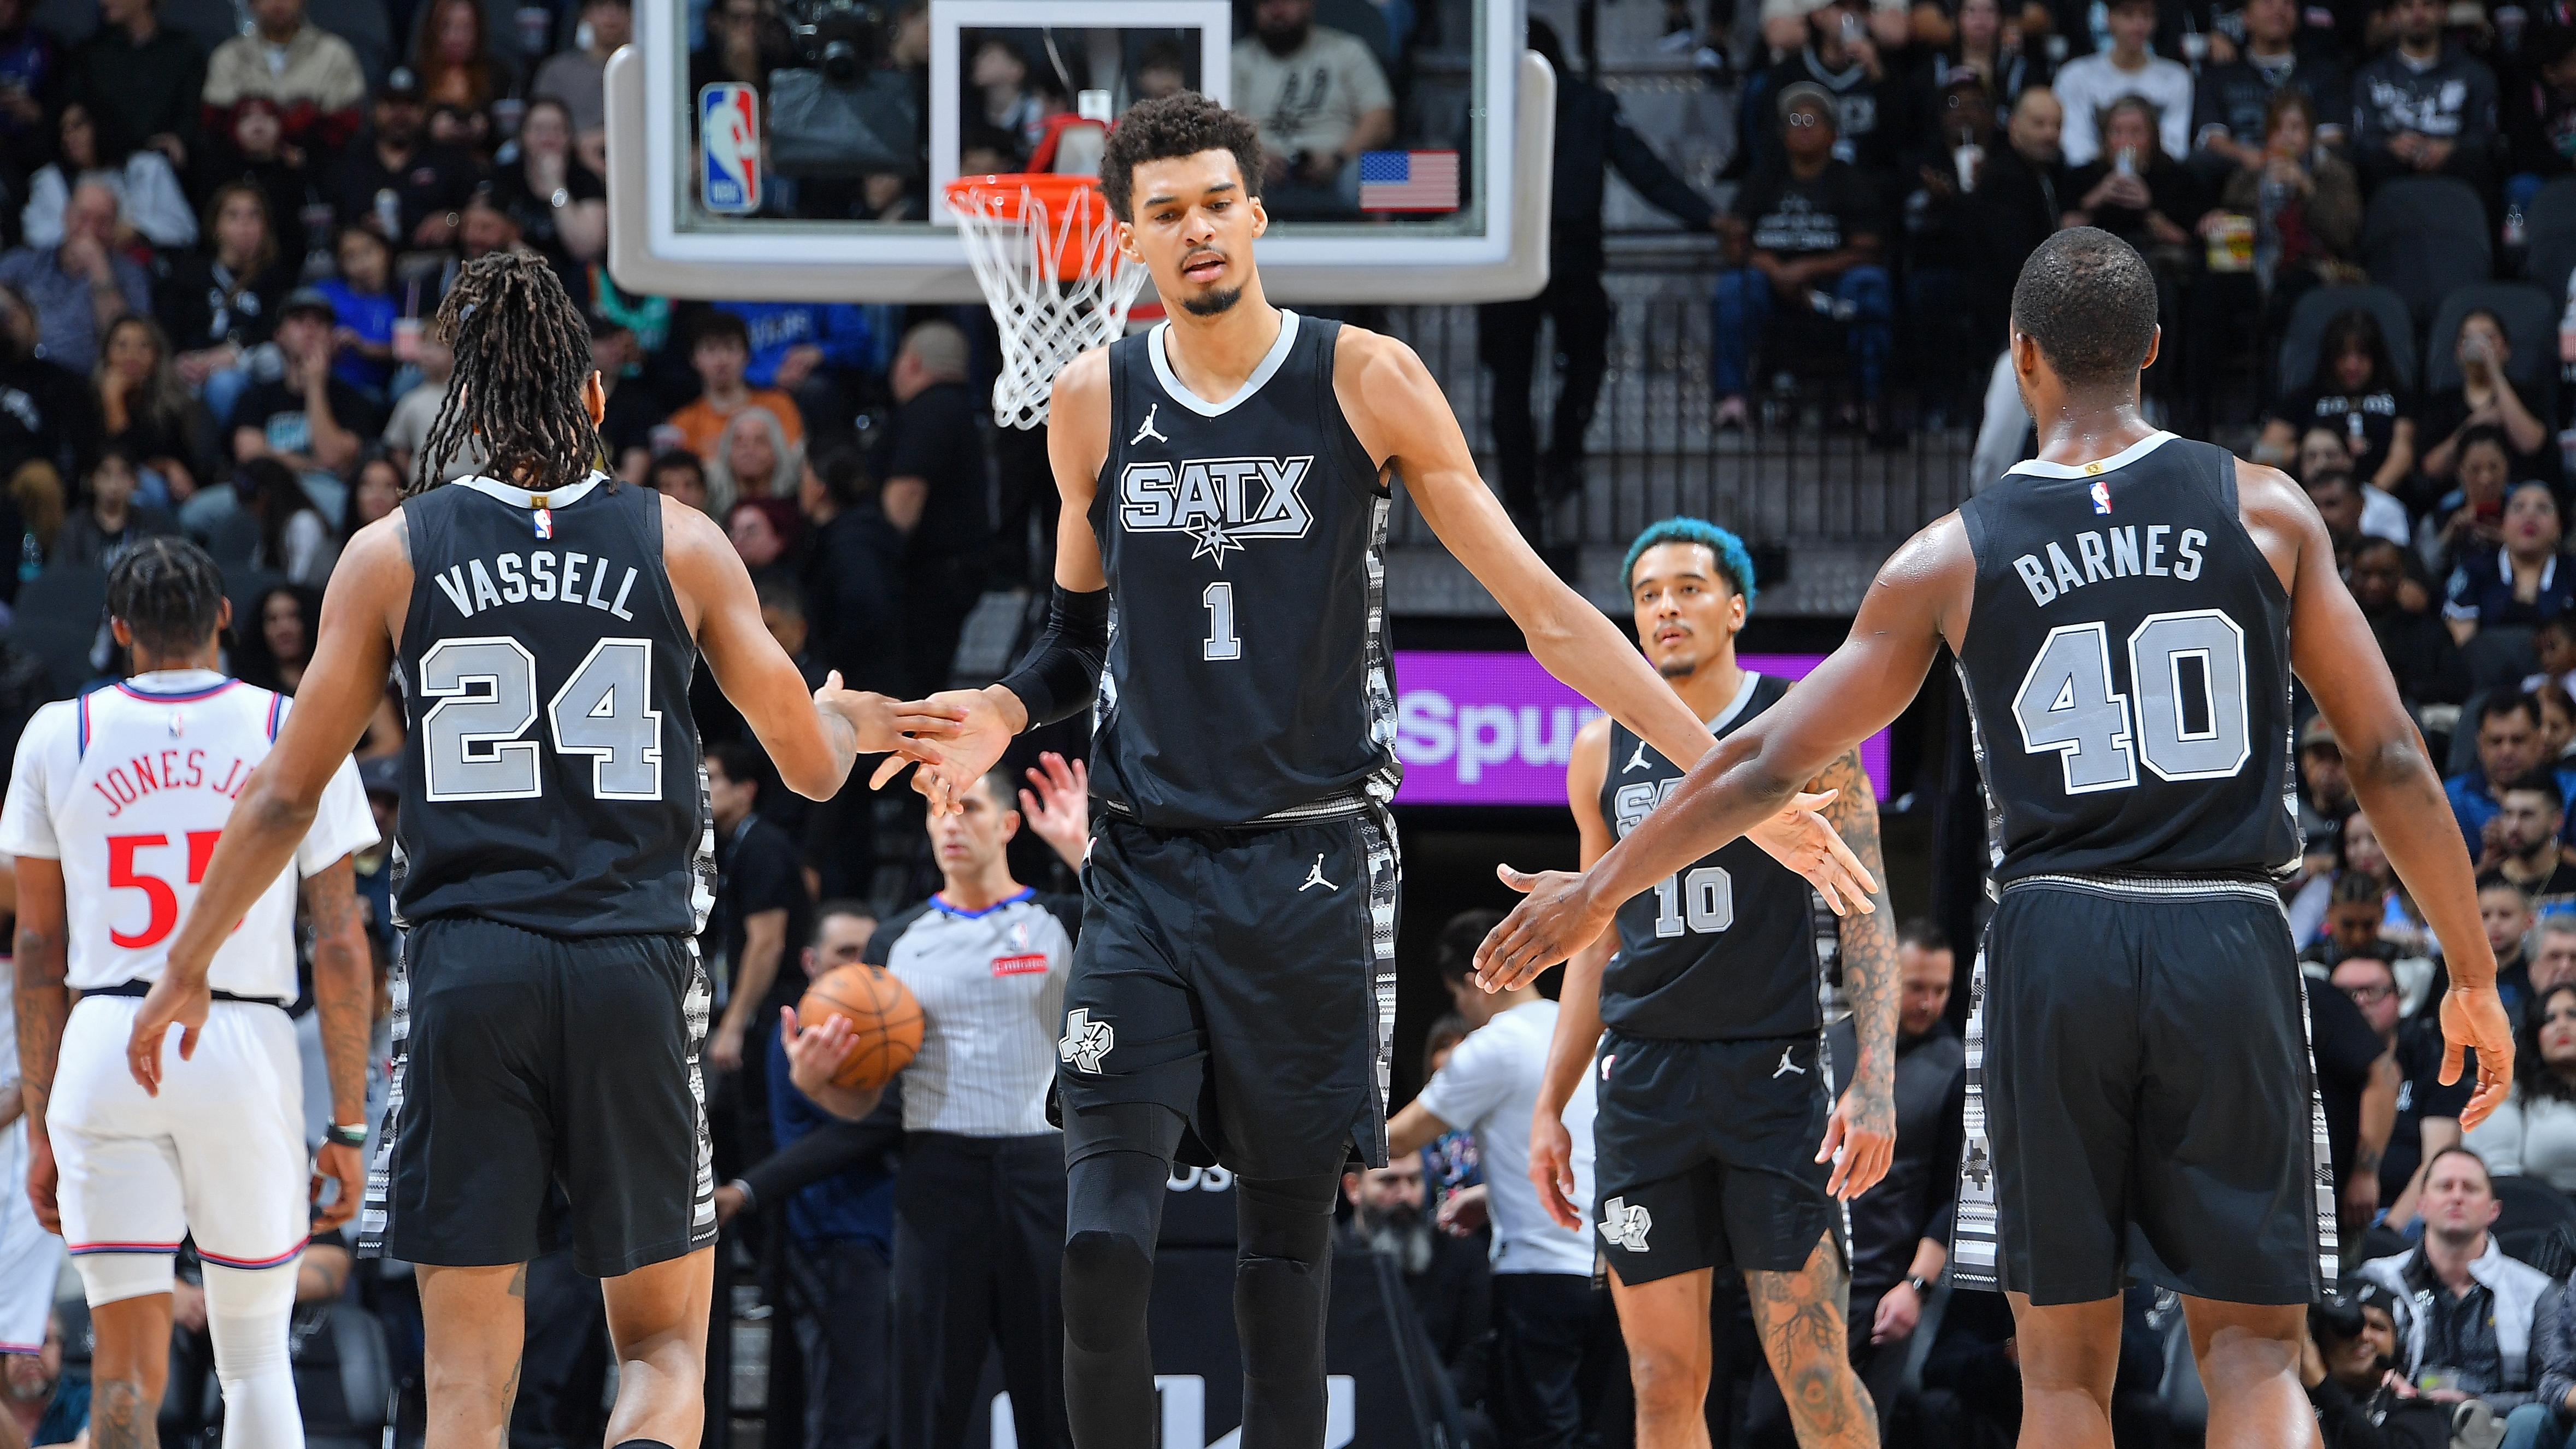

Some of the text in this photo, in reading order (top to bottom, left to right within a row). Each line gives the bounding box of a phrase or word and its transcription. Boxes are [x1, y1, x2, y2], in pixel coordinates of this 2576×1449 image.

[1120, 456, 1314, 540] SATX
[434, 550, 639, 622] VASSELL
[2012, 525, 2208, 607] BARNES
[1203, 581, 1242, 661] 1
[419, 636, 662, 802] 24
[2012, 608, 2252, 796] 40
[93, 750, 205, 817] JONES
[1654, 867, 1734, 939] 10
